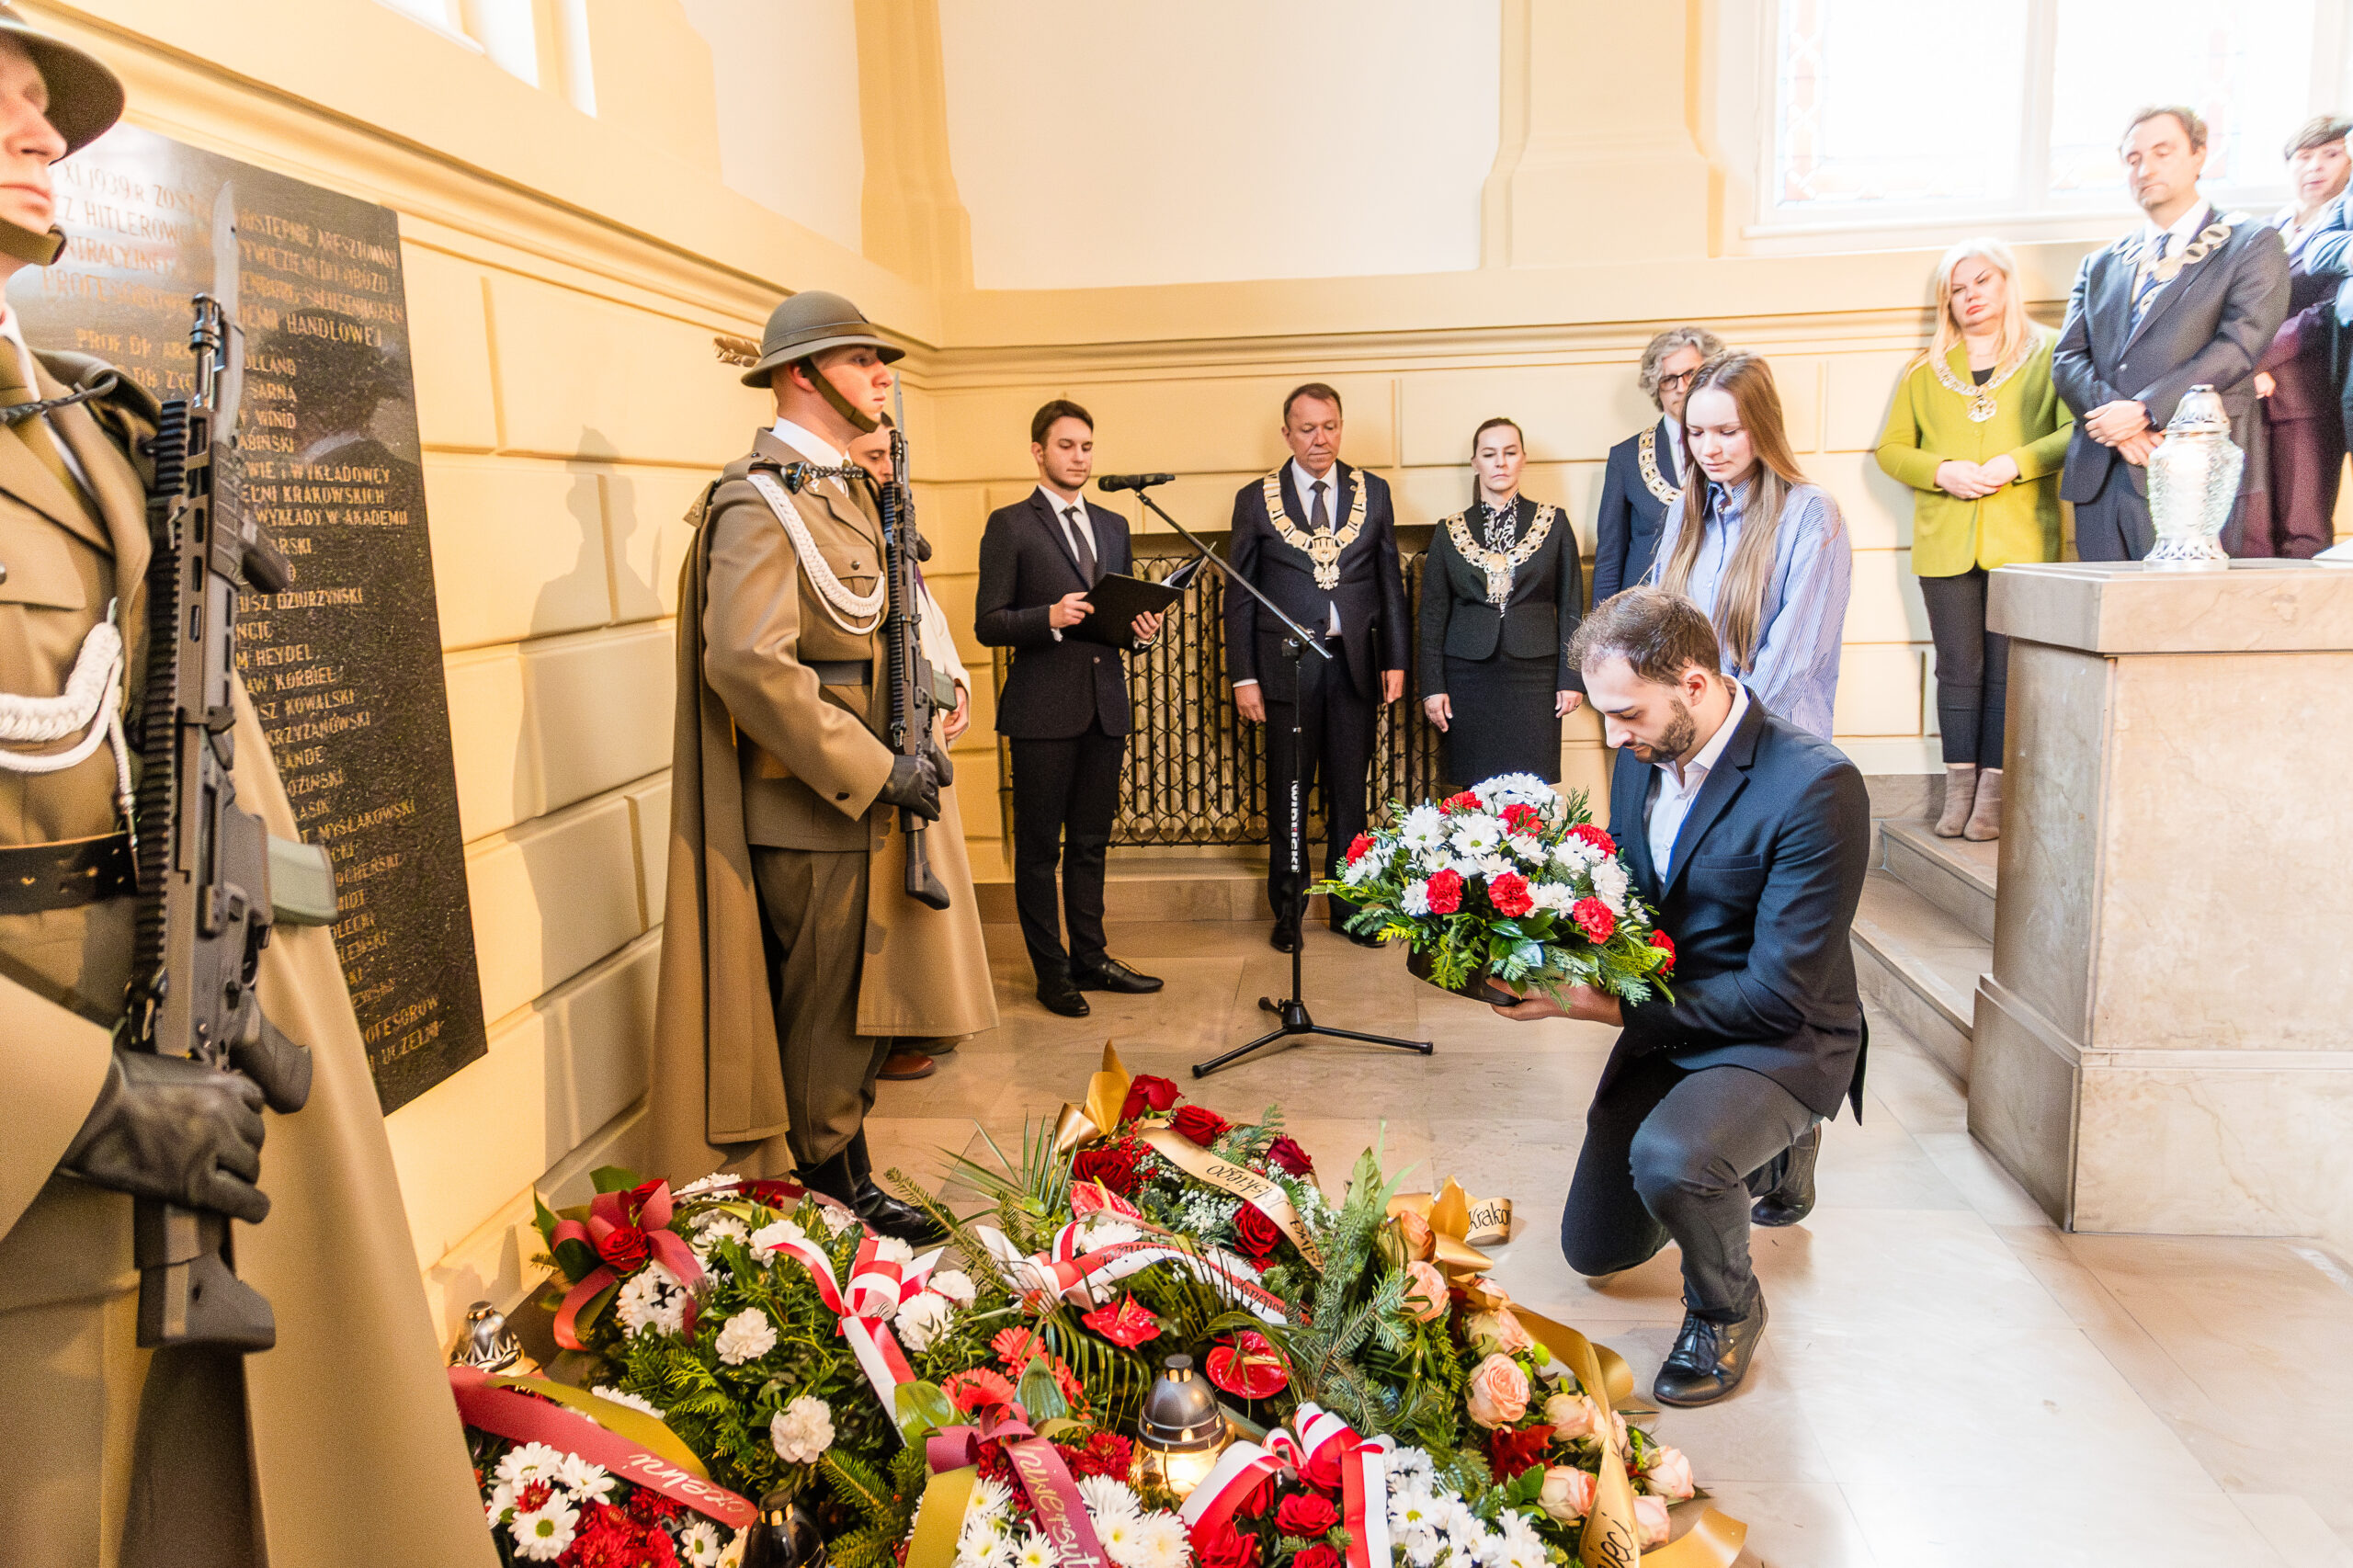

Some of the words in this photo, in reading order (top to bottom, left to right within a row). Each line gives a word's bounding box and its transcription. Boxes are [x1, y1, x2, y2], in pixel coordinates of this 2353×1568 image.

[89, 168, 131, 199] 1939
[282, 485, 385, 506] KRAKOWSKICH
[256, 643, 314, 666] HEYDEL
[284, 688, 356, 717] KOWALSKI
